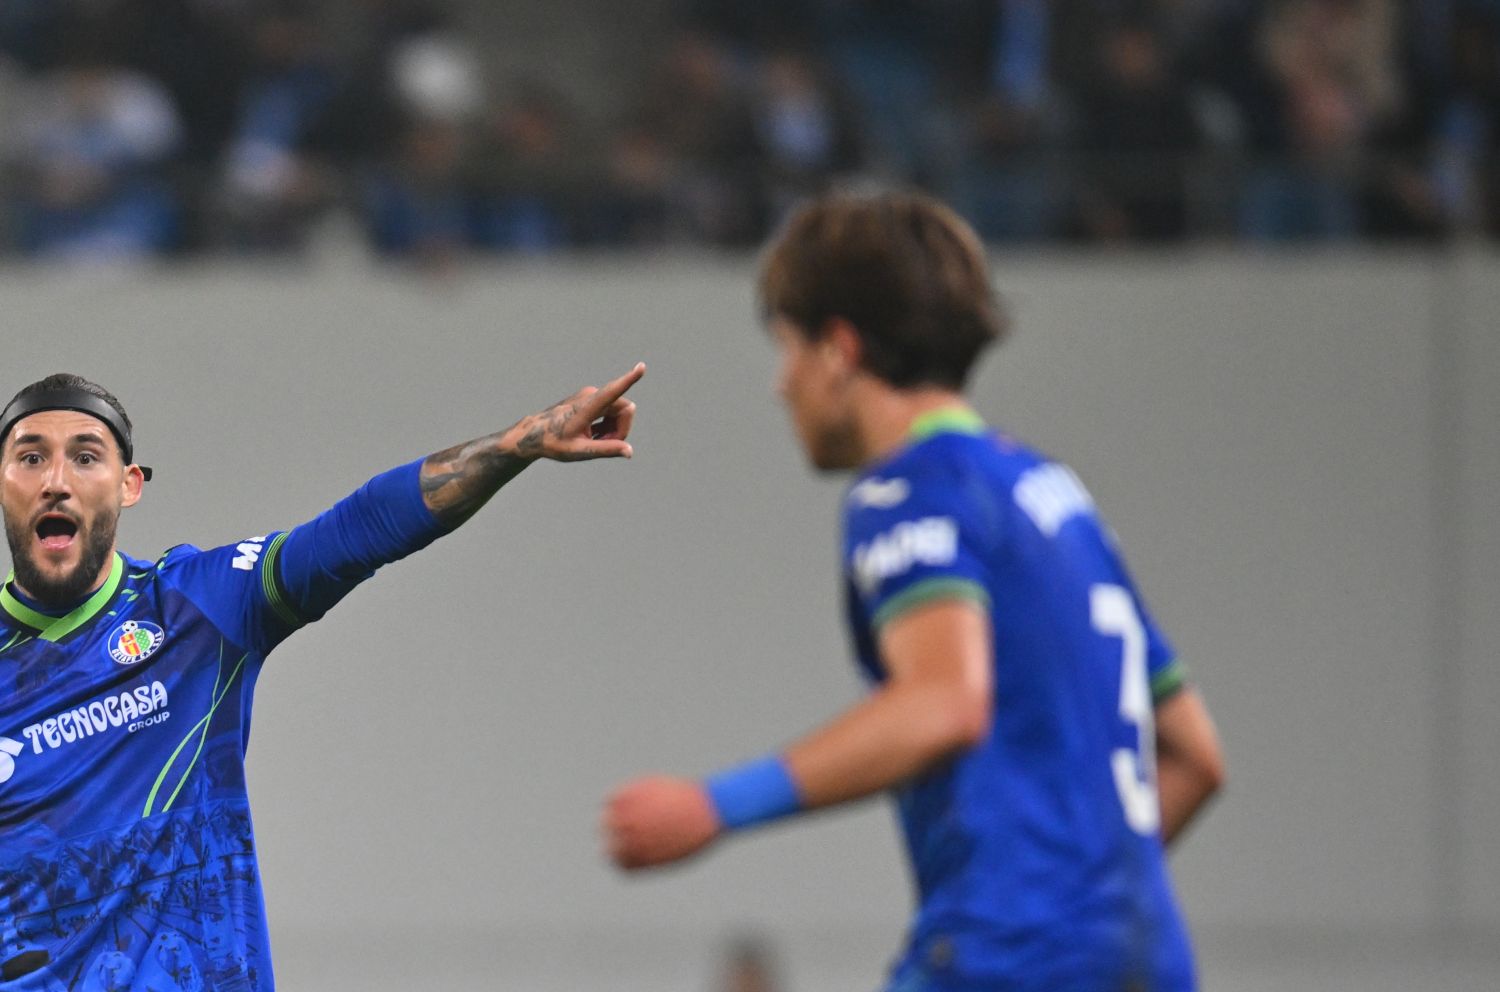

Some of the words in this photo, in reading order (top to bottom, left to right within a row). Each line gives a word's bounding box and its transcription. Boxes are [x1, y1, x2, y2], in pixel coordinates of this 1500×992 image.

[22, 680, 168, 754] TECNOCASA
[127, 711, 171, 733] GROUP
[1089, 582, 1159, 837] 3
